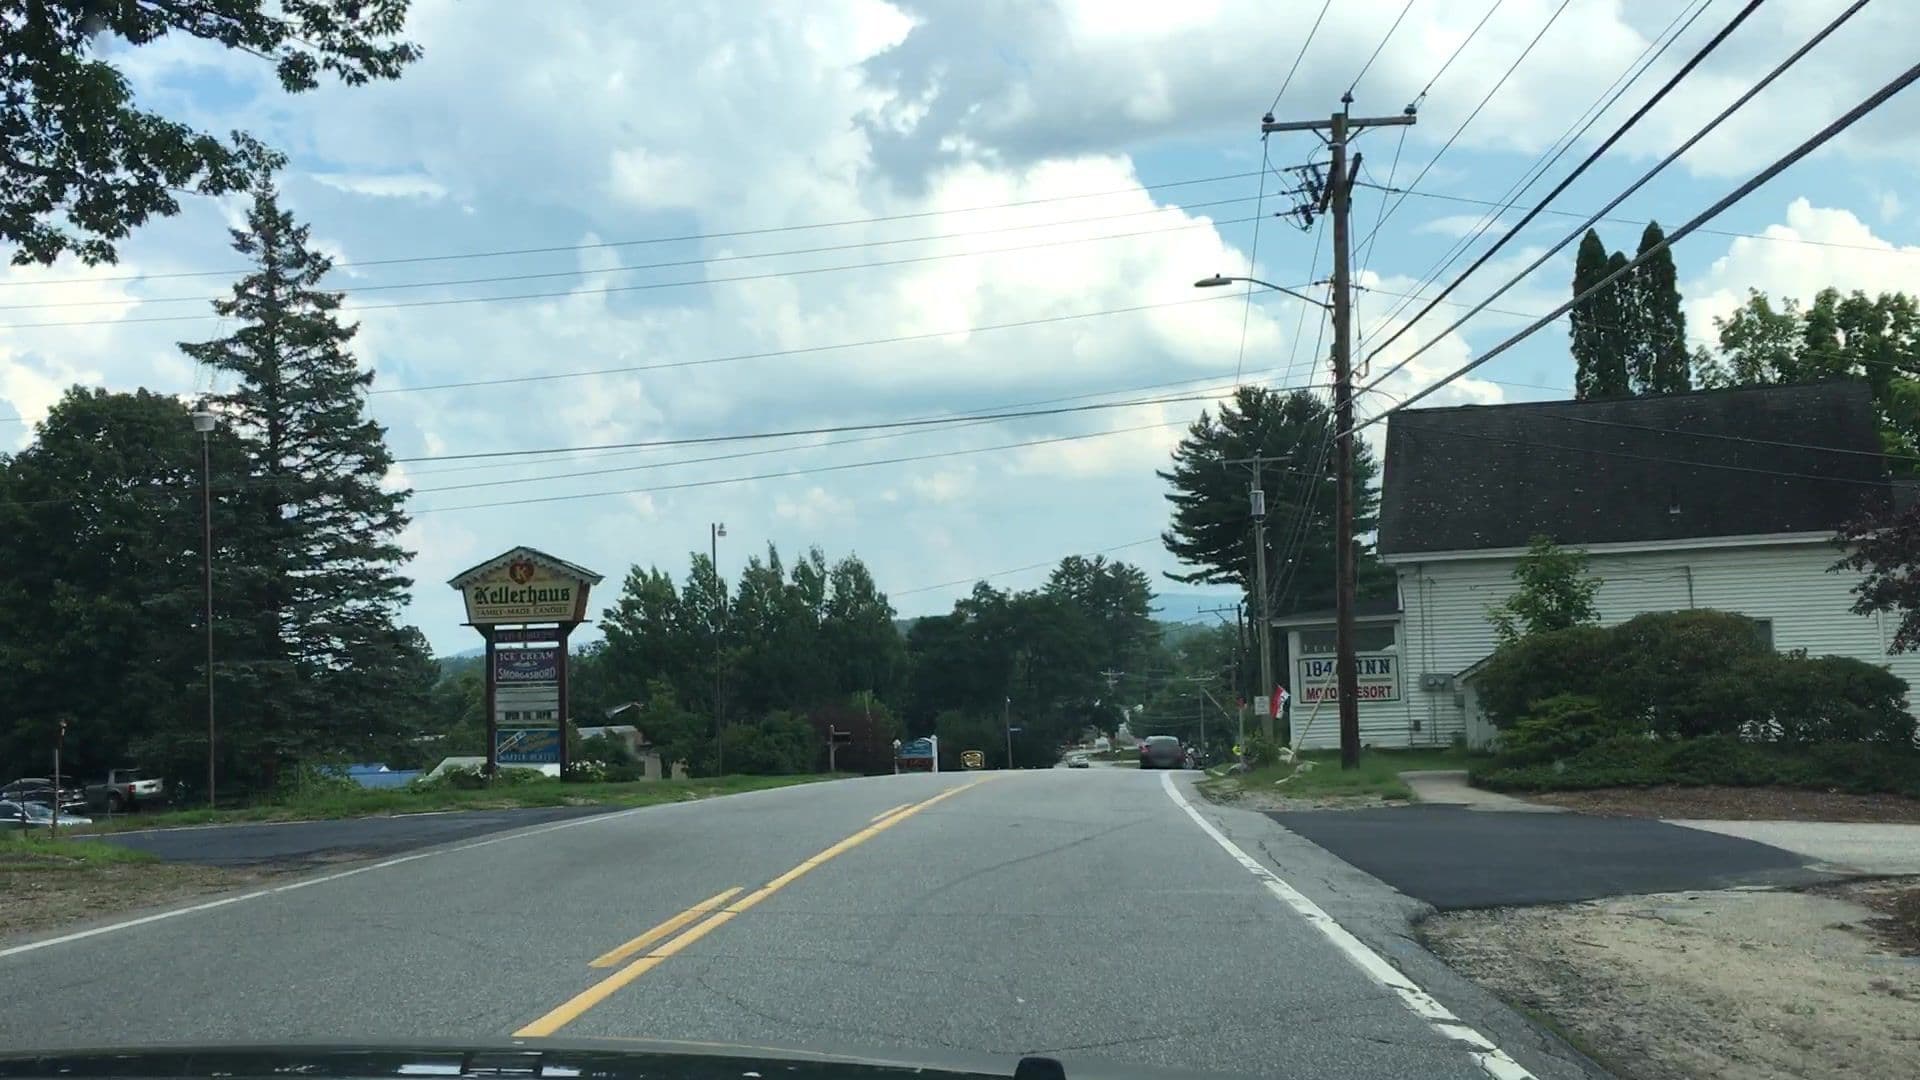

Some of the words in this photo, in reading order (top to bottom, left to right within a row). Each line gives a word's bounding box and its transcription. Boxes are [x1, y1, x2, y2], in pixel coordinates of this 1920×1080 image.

[474, 585, 570, 605] Kellerhaus
[533, 606, 568, 614] CANDIES
[499, 652, 515, 662] ICE
[520, 652, 554, 661] CREAM
[498, 667, 556, 680] SMORGASBORD
[1305, 661, 1339, 677] 184
[1356, 658, 1390, 675] INN
[1306, 687, 1337, 700] MOTO
[1355, 685, 1392, 699] ESORT
